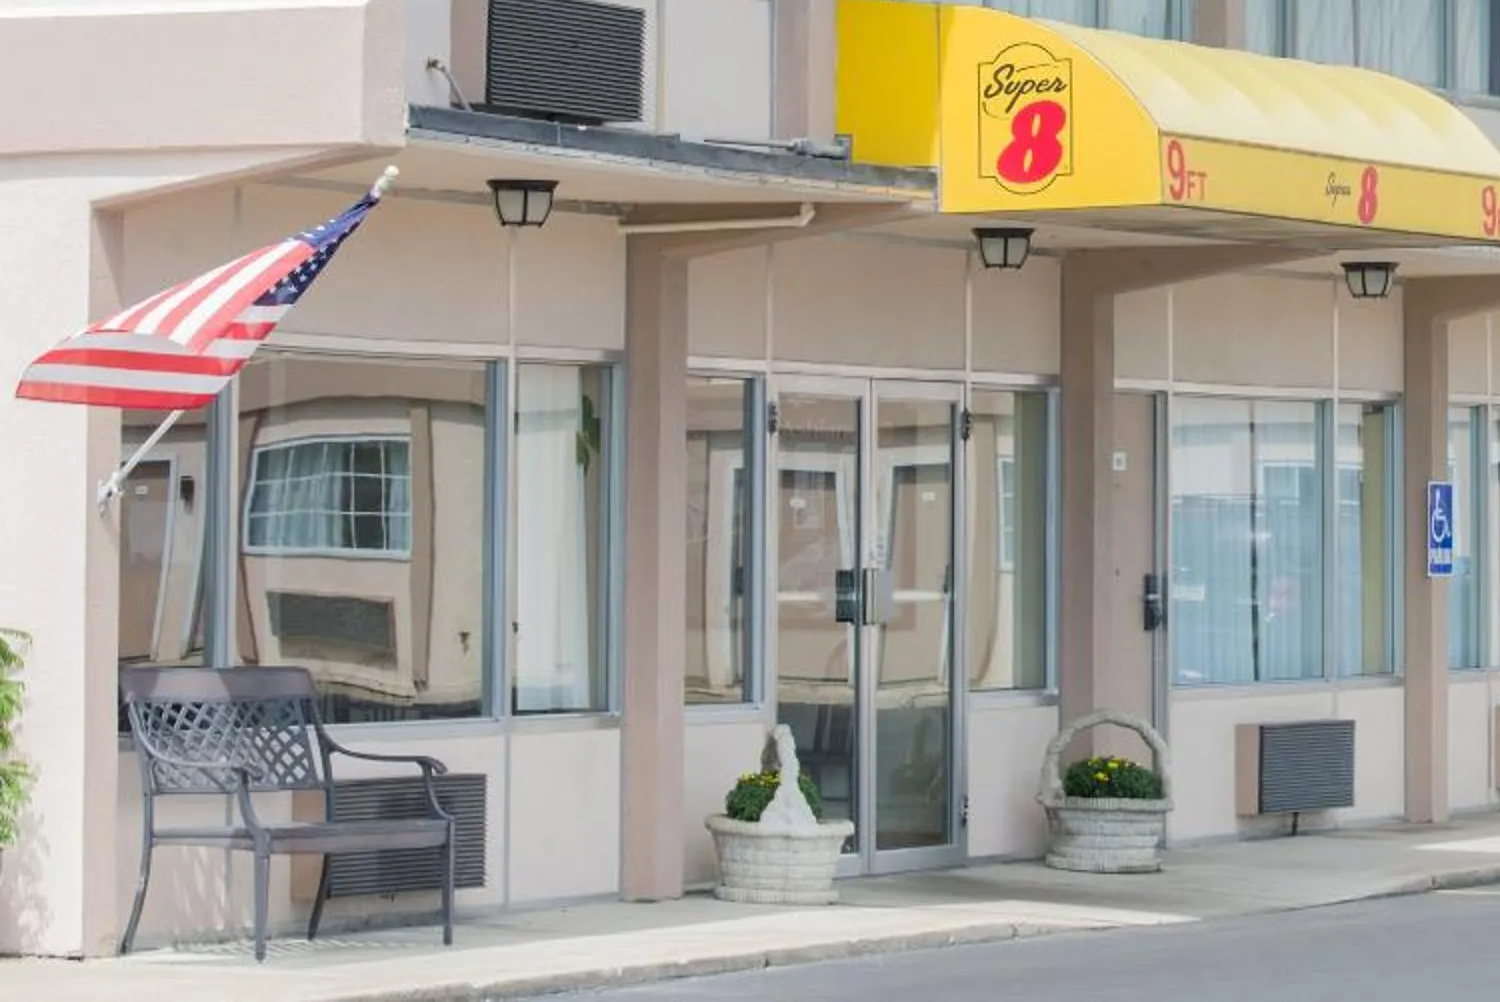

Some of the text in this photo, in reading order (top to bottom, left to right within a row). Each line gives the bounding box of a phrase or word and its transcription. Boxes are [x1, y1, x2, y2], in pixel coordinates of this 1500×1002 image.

[984, 63, 1068, 115] Super
[996, 100, 1067, 184] 8
[1357, 165, 1379, 225] 8
